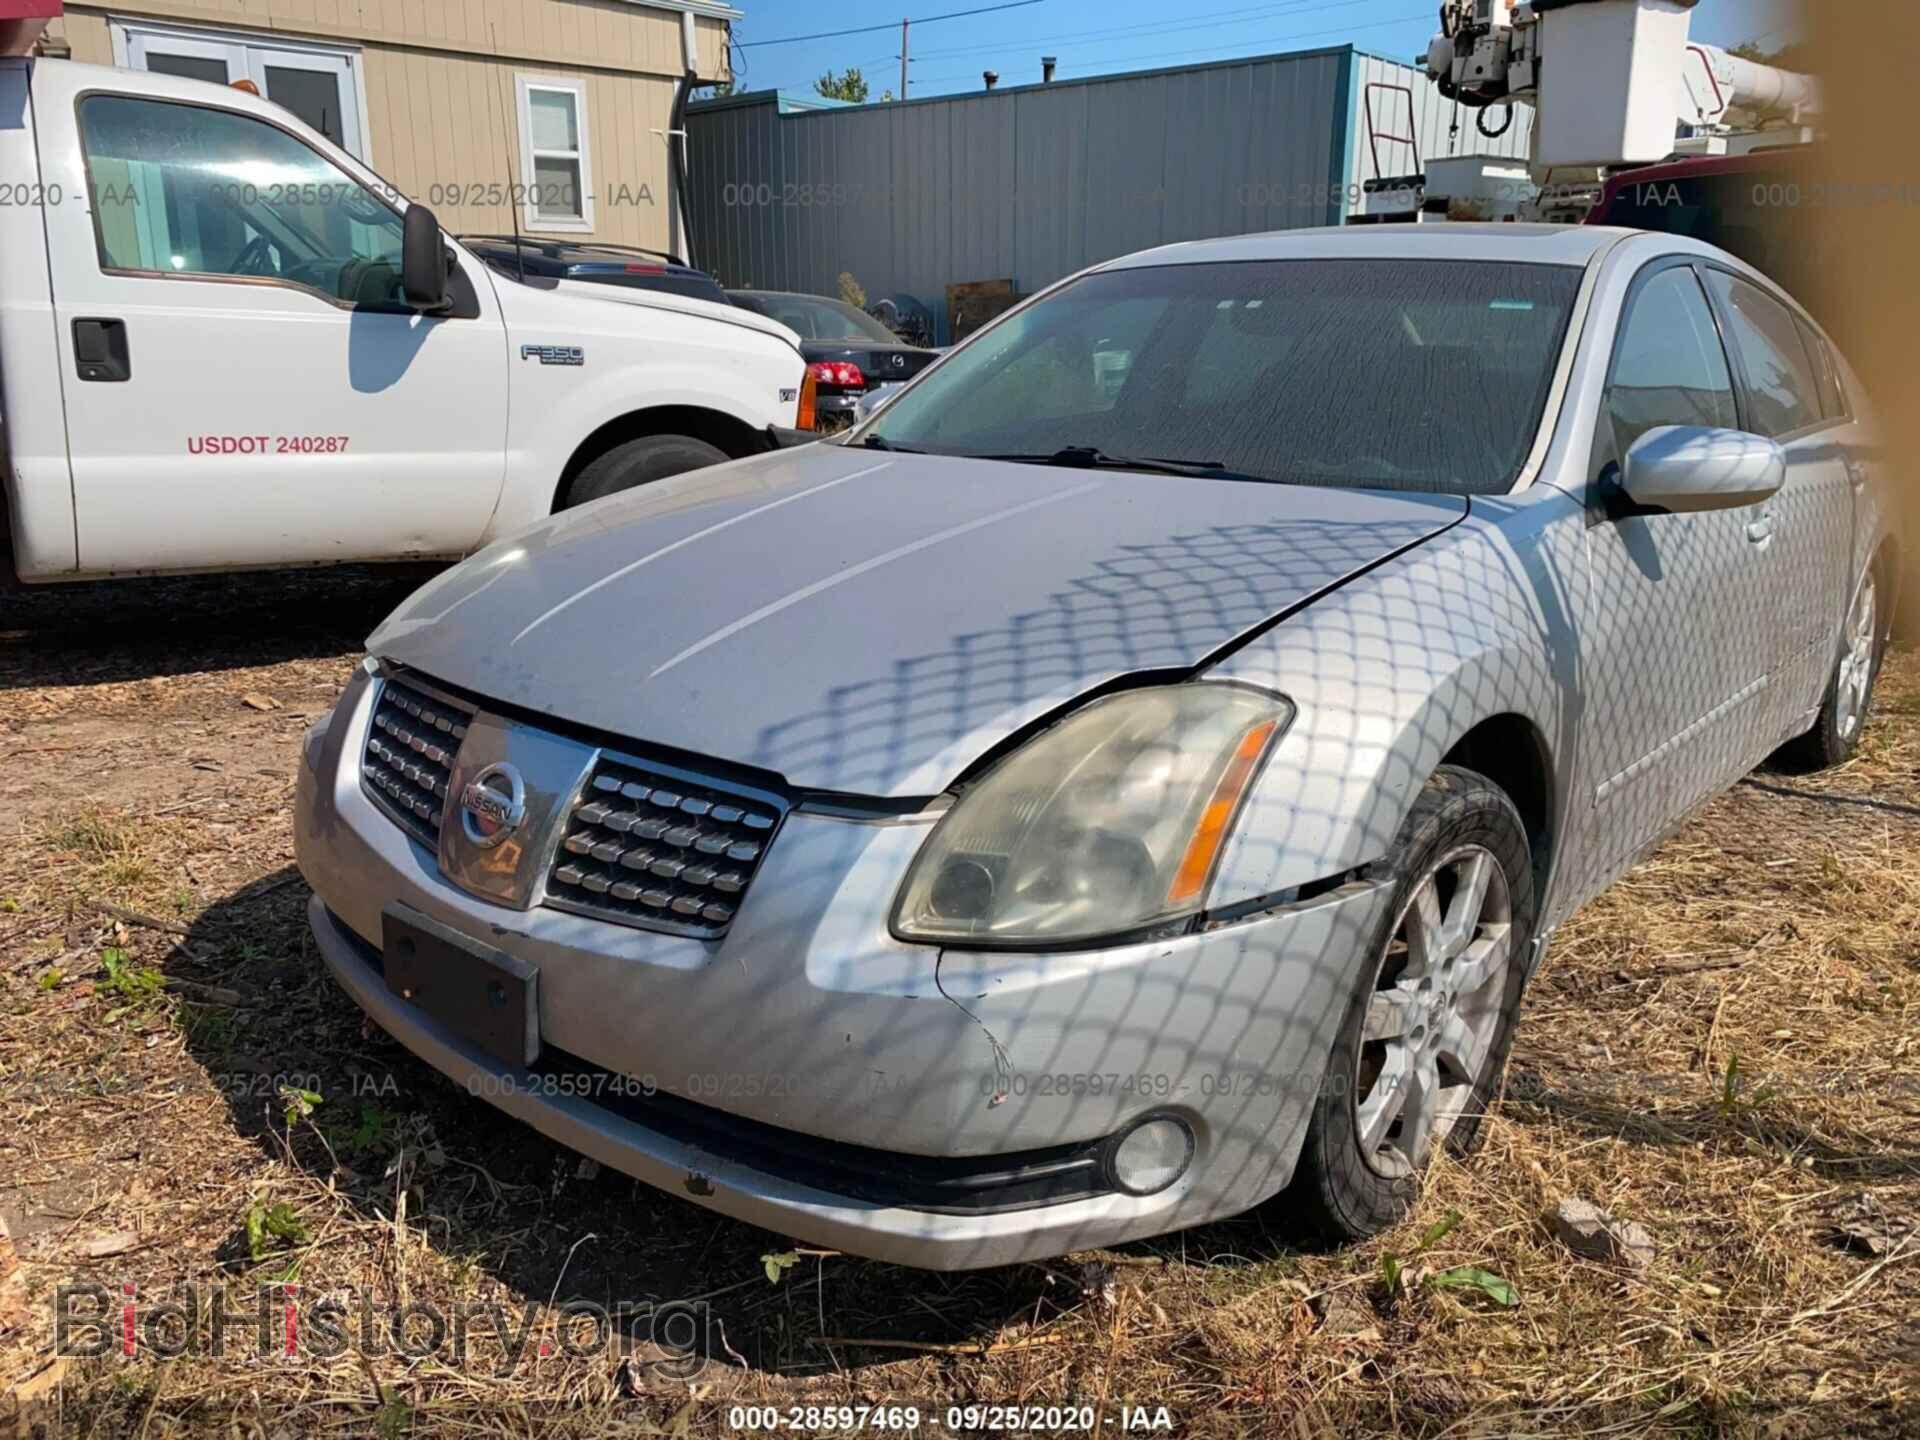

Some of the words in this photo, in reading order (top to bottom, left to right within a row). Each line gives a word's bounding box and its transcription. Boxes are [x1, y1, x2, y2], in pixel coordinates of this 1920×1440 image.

[188, 436, 269, 454] USDOT
[276, 436, 349, 453] 240287
[462, 789, 513, 820] NISSAN
